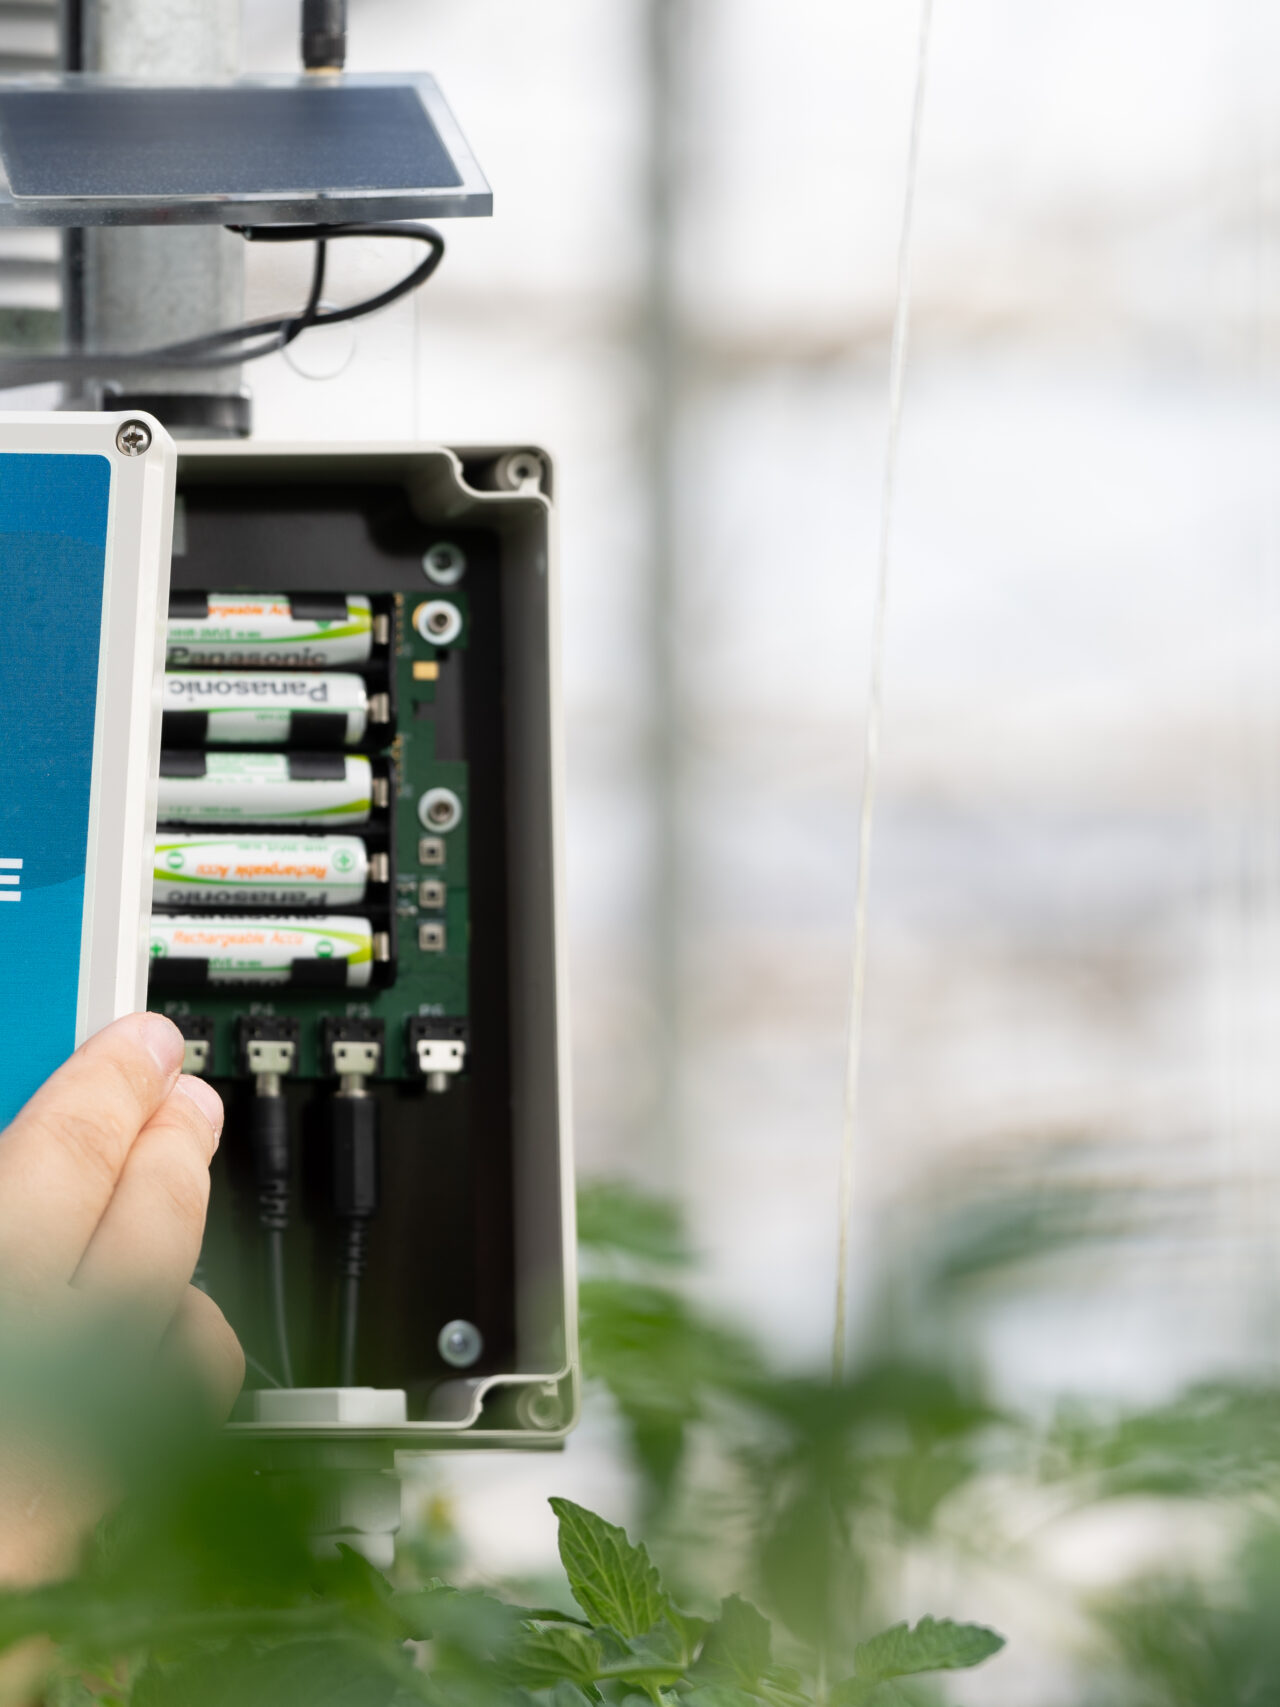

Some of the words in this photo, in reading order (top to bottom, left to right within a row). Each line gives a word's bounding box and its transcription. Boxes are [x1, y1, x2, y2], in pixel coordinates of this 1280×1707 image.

[170, 646, 327, 666] Panasonic
[169, 680, 328, 702] Panasonic
[173, 930, 265, 947] Rechargeable
